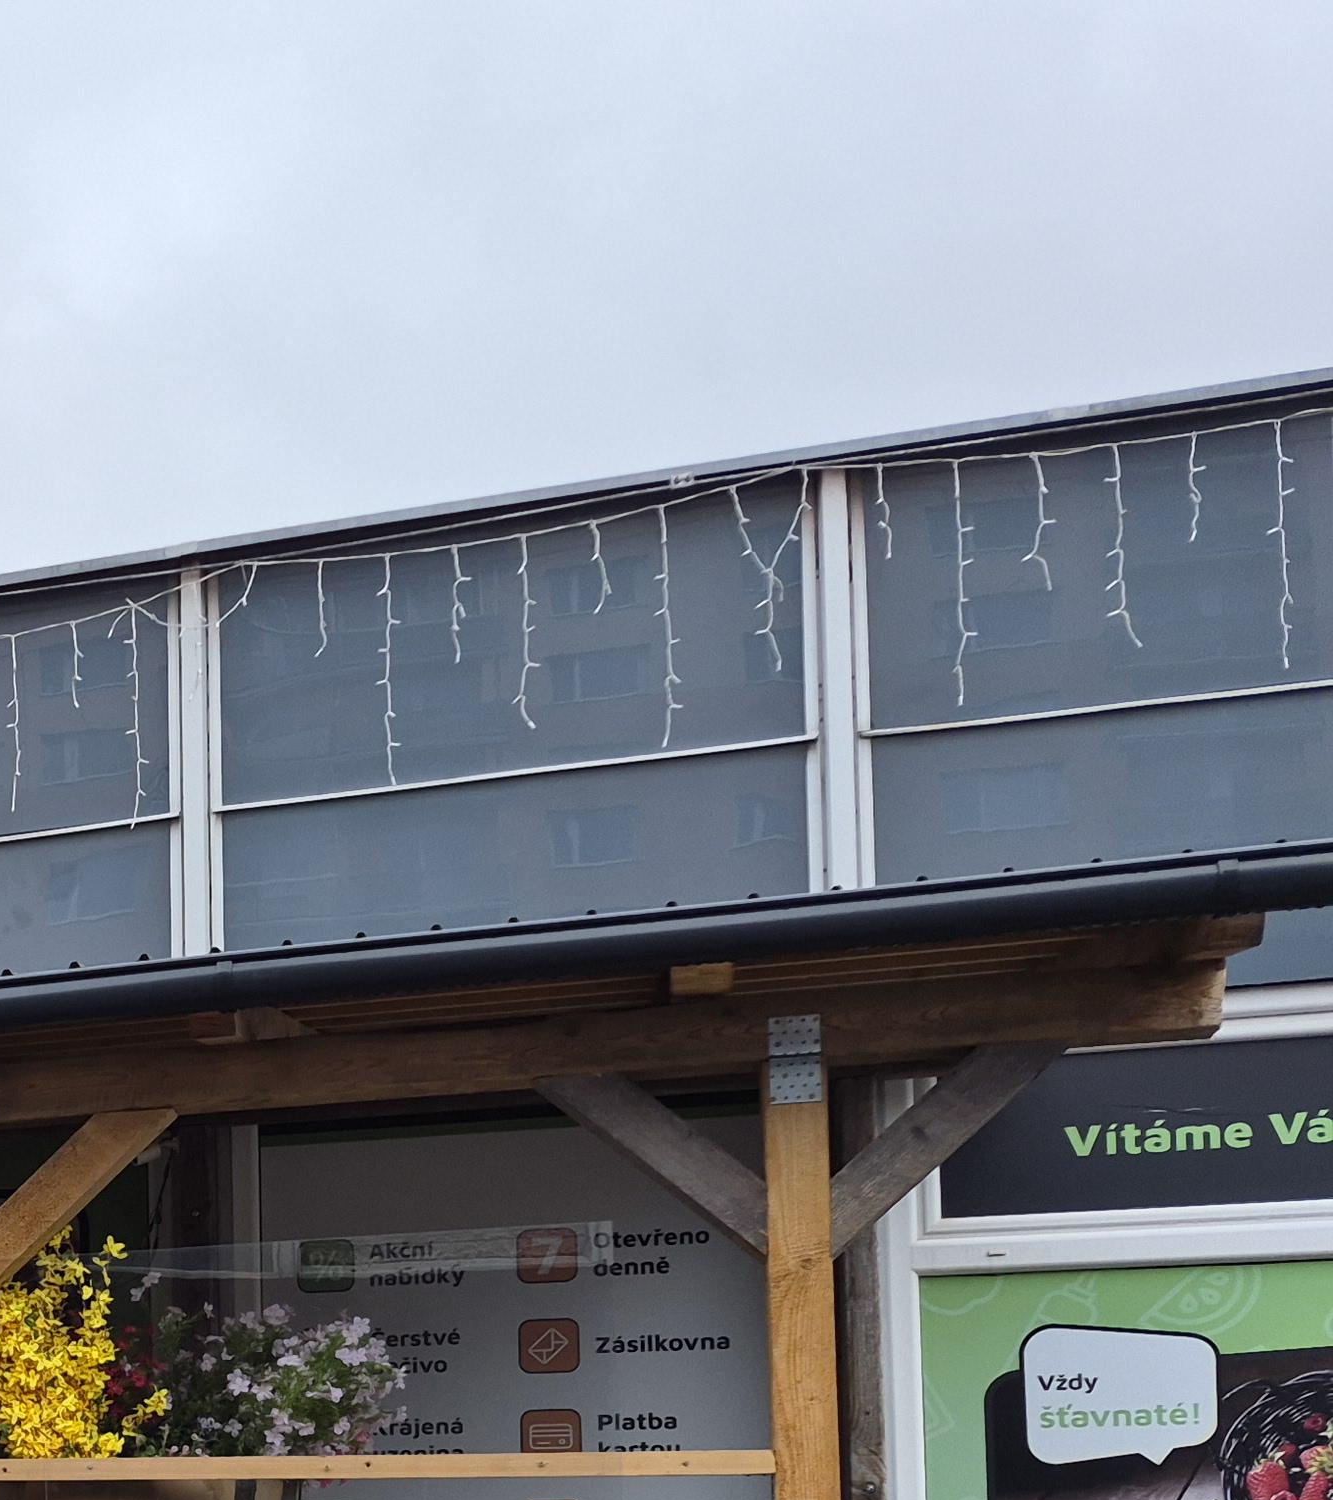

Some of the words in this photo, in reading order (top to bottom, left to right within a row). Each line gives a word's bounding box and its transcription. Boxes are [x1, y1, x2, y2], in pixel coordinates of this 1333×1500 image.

[1064, 1120, 1253, 1158] Vítáme
[593, 1227, 710, 1250] Otevřeno
[369, 1241, 435, 1261] Akční
[369, 1263, 465, 1289] nabídky
[593, 1257, 671, 1277] denně
[596, 1332, 731, 1355] Zásilkovna
[389, 1357, 448, 1374] čivo
[1037, 1371, 1099, 1396] Vždy
[598, 1412, 678, 1432] Platba
[1038, 1401, 1201, 1429] šťavnaté!
